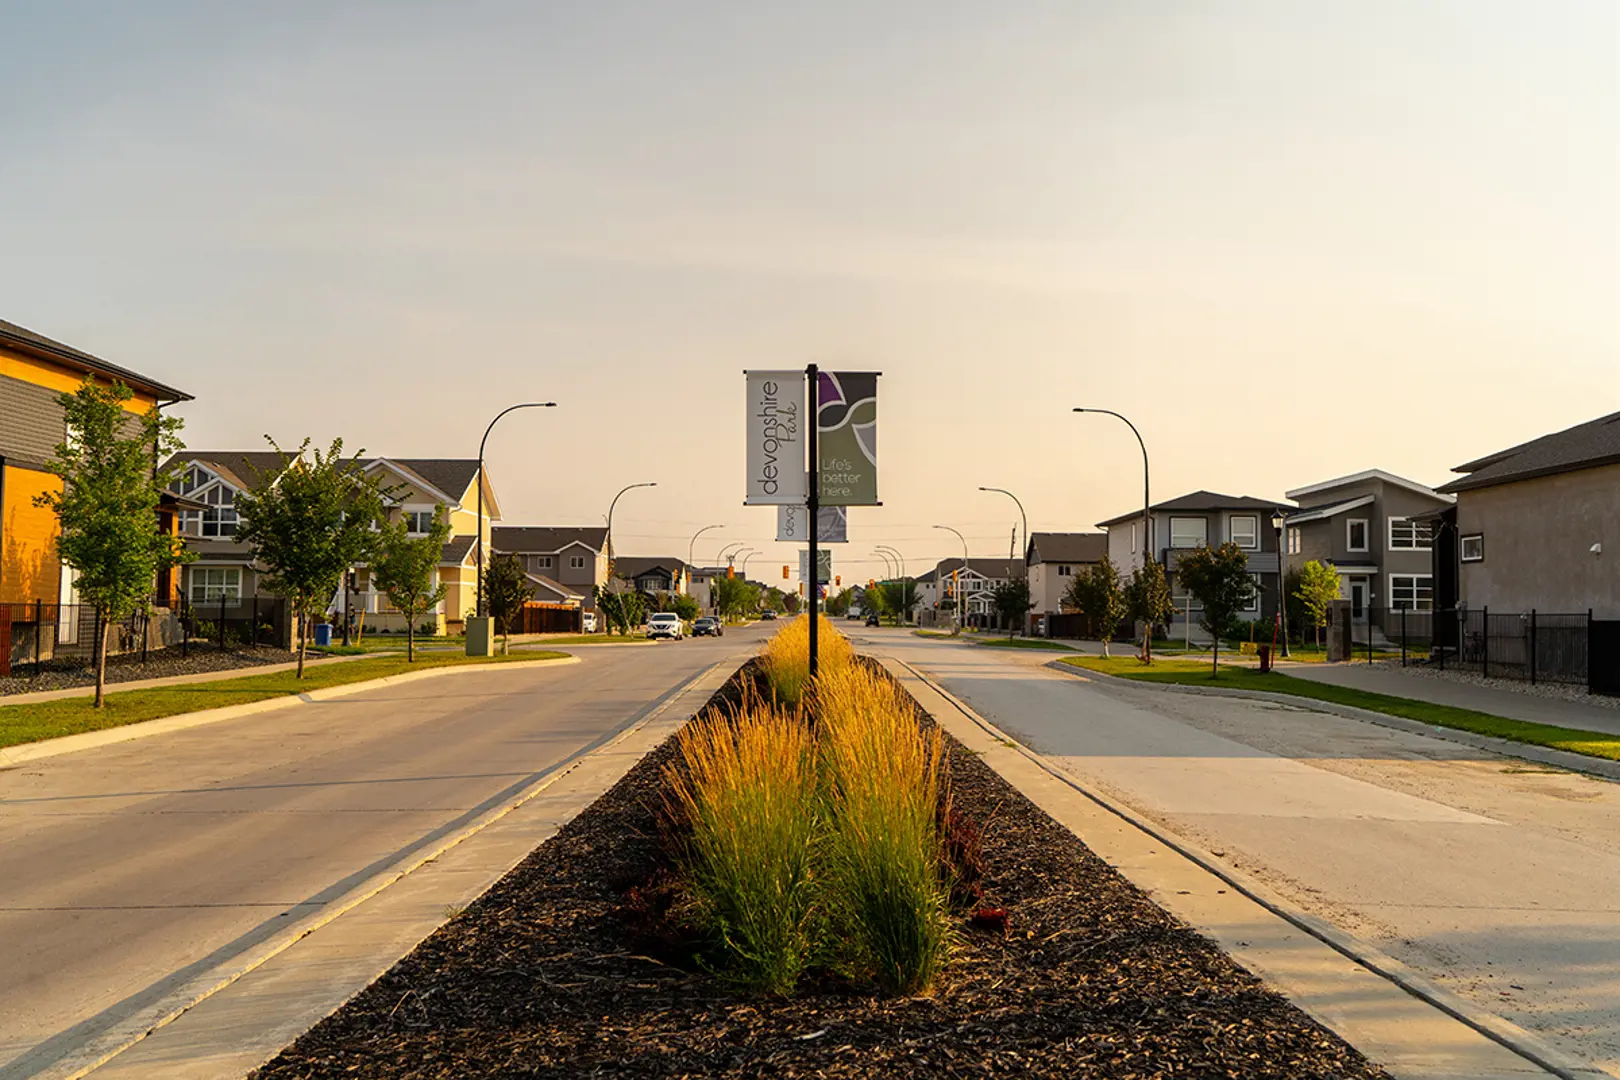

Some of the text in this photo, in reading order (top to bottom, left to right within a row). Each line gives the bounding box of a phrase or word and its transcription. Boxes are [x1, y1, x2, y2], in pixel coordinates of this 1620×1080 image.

[775, 401, 797, 448] Park
[757, 381, 778, 495] devonshire
[822, 458, 852, 471] Life's
[822, 472, 861, 484] better
[822, 483, 852, 496] here.
